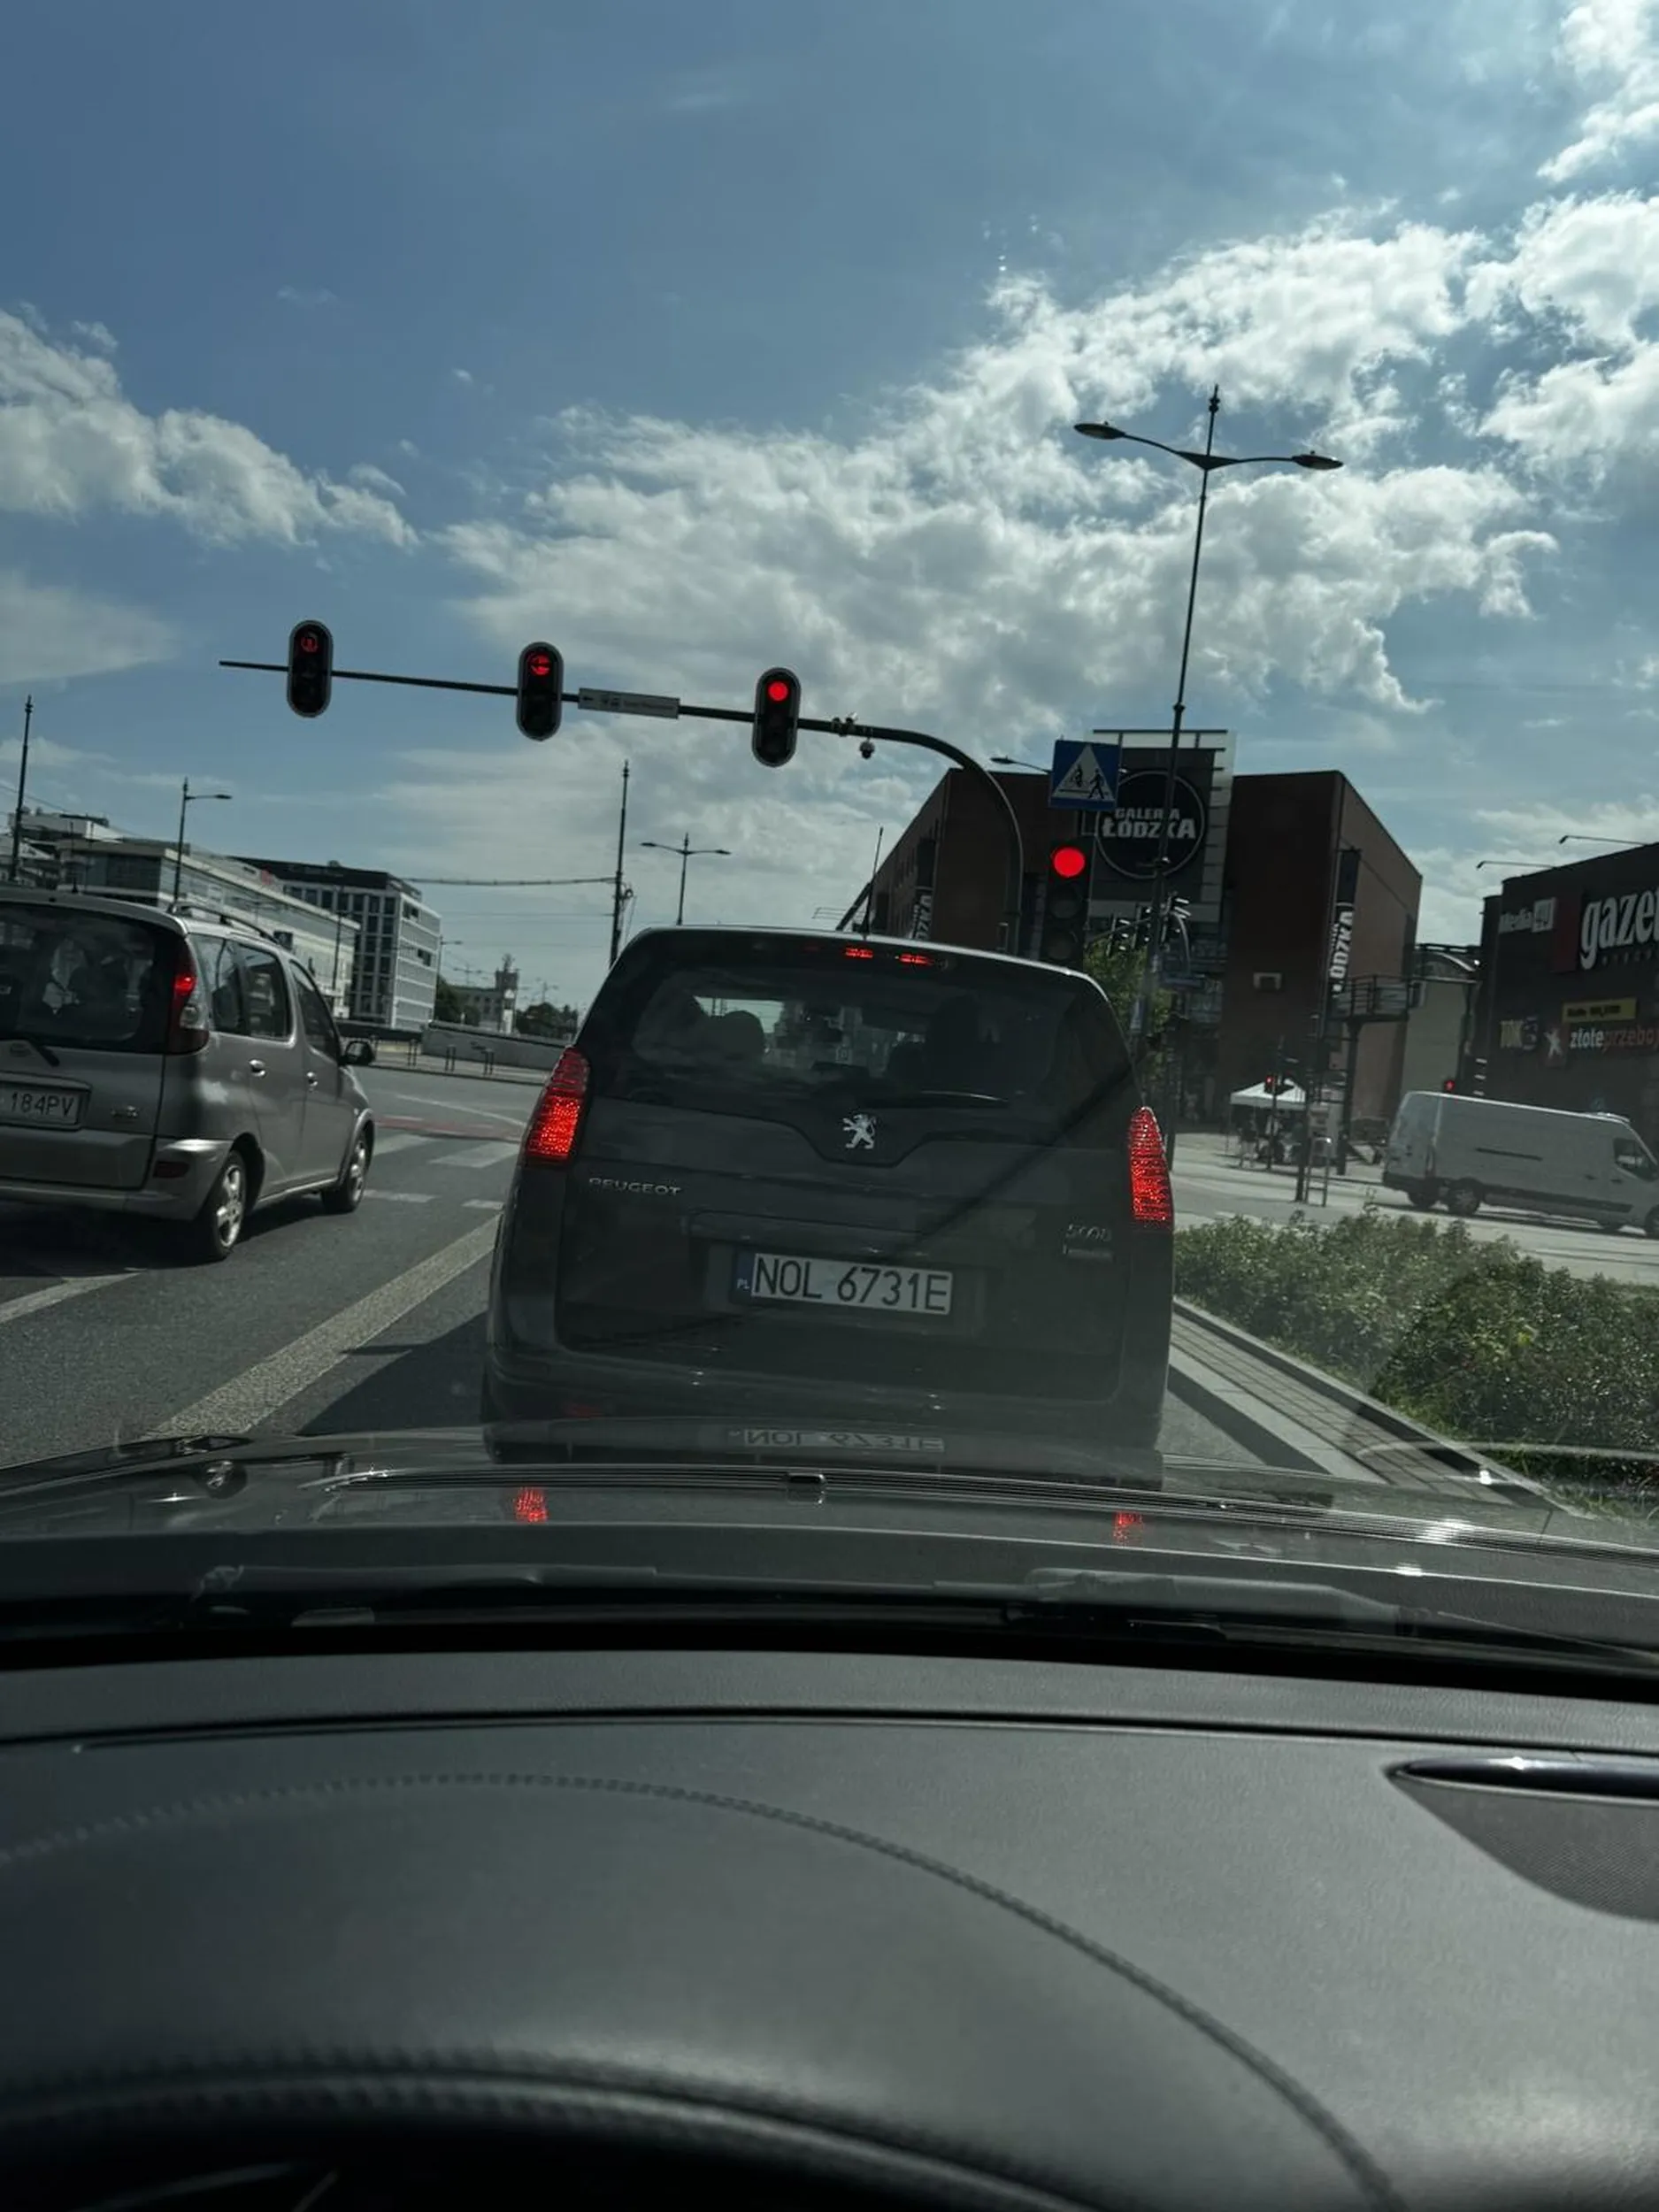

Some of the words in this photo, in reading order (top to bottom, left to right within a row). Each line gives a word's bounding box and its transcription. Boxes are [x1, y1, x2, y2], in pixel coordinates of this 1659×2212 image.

[1114, 807, 1181, 821] GALERA
[11, 1091, 75, 1118] 184PV
[588, 1177, 682, 1197] PEUGEOT
[753, 1256, 823, 1299] NOL
[836, 1266, 950, 1312] 6731E
